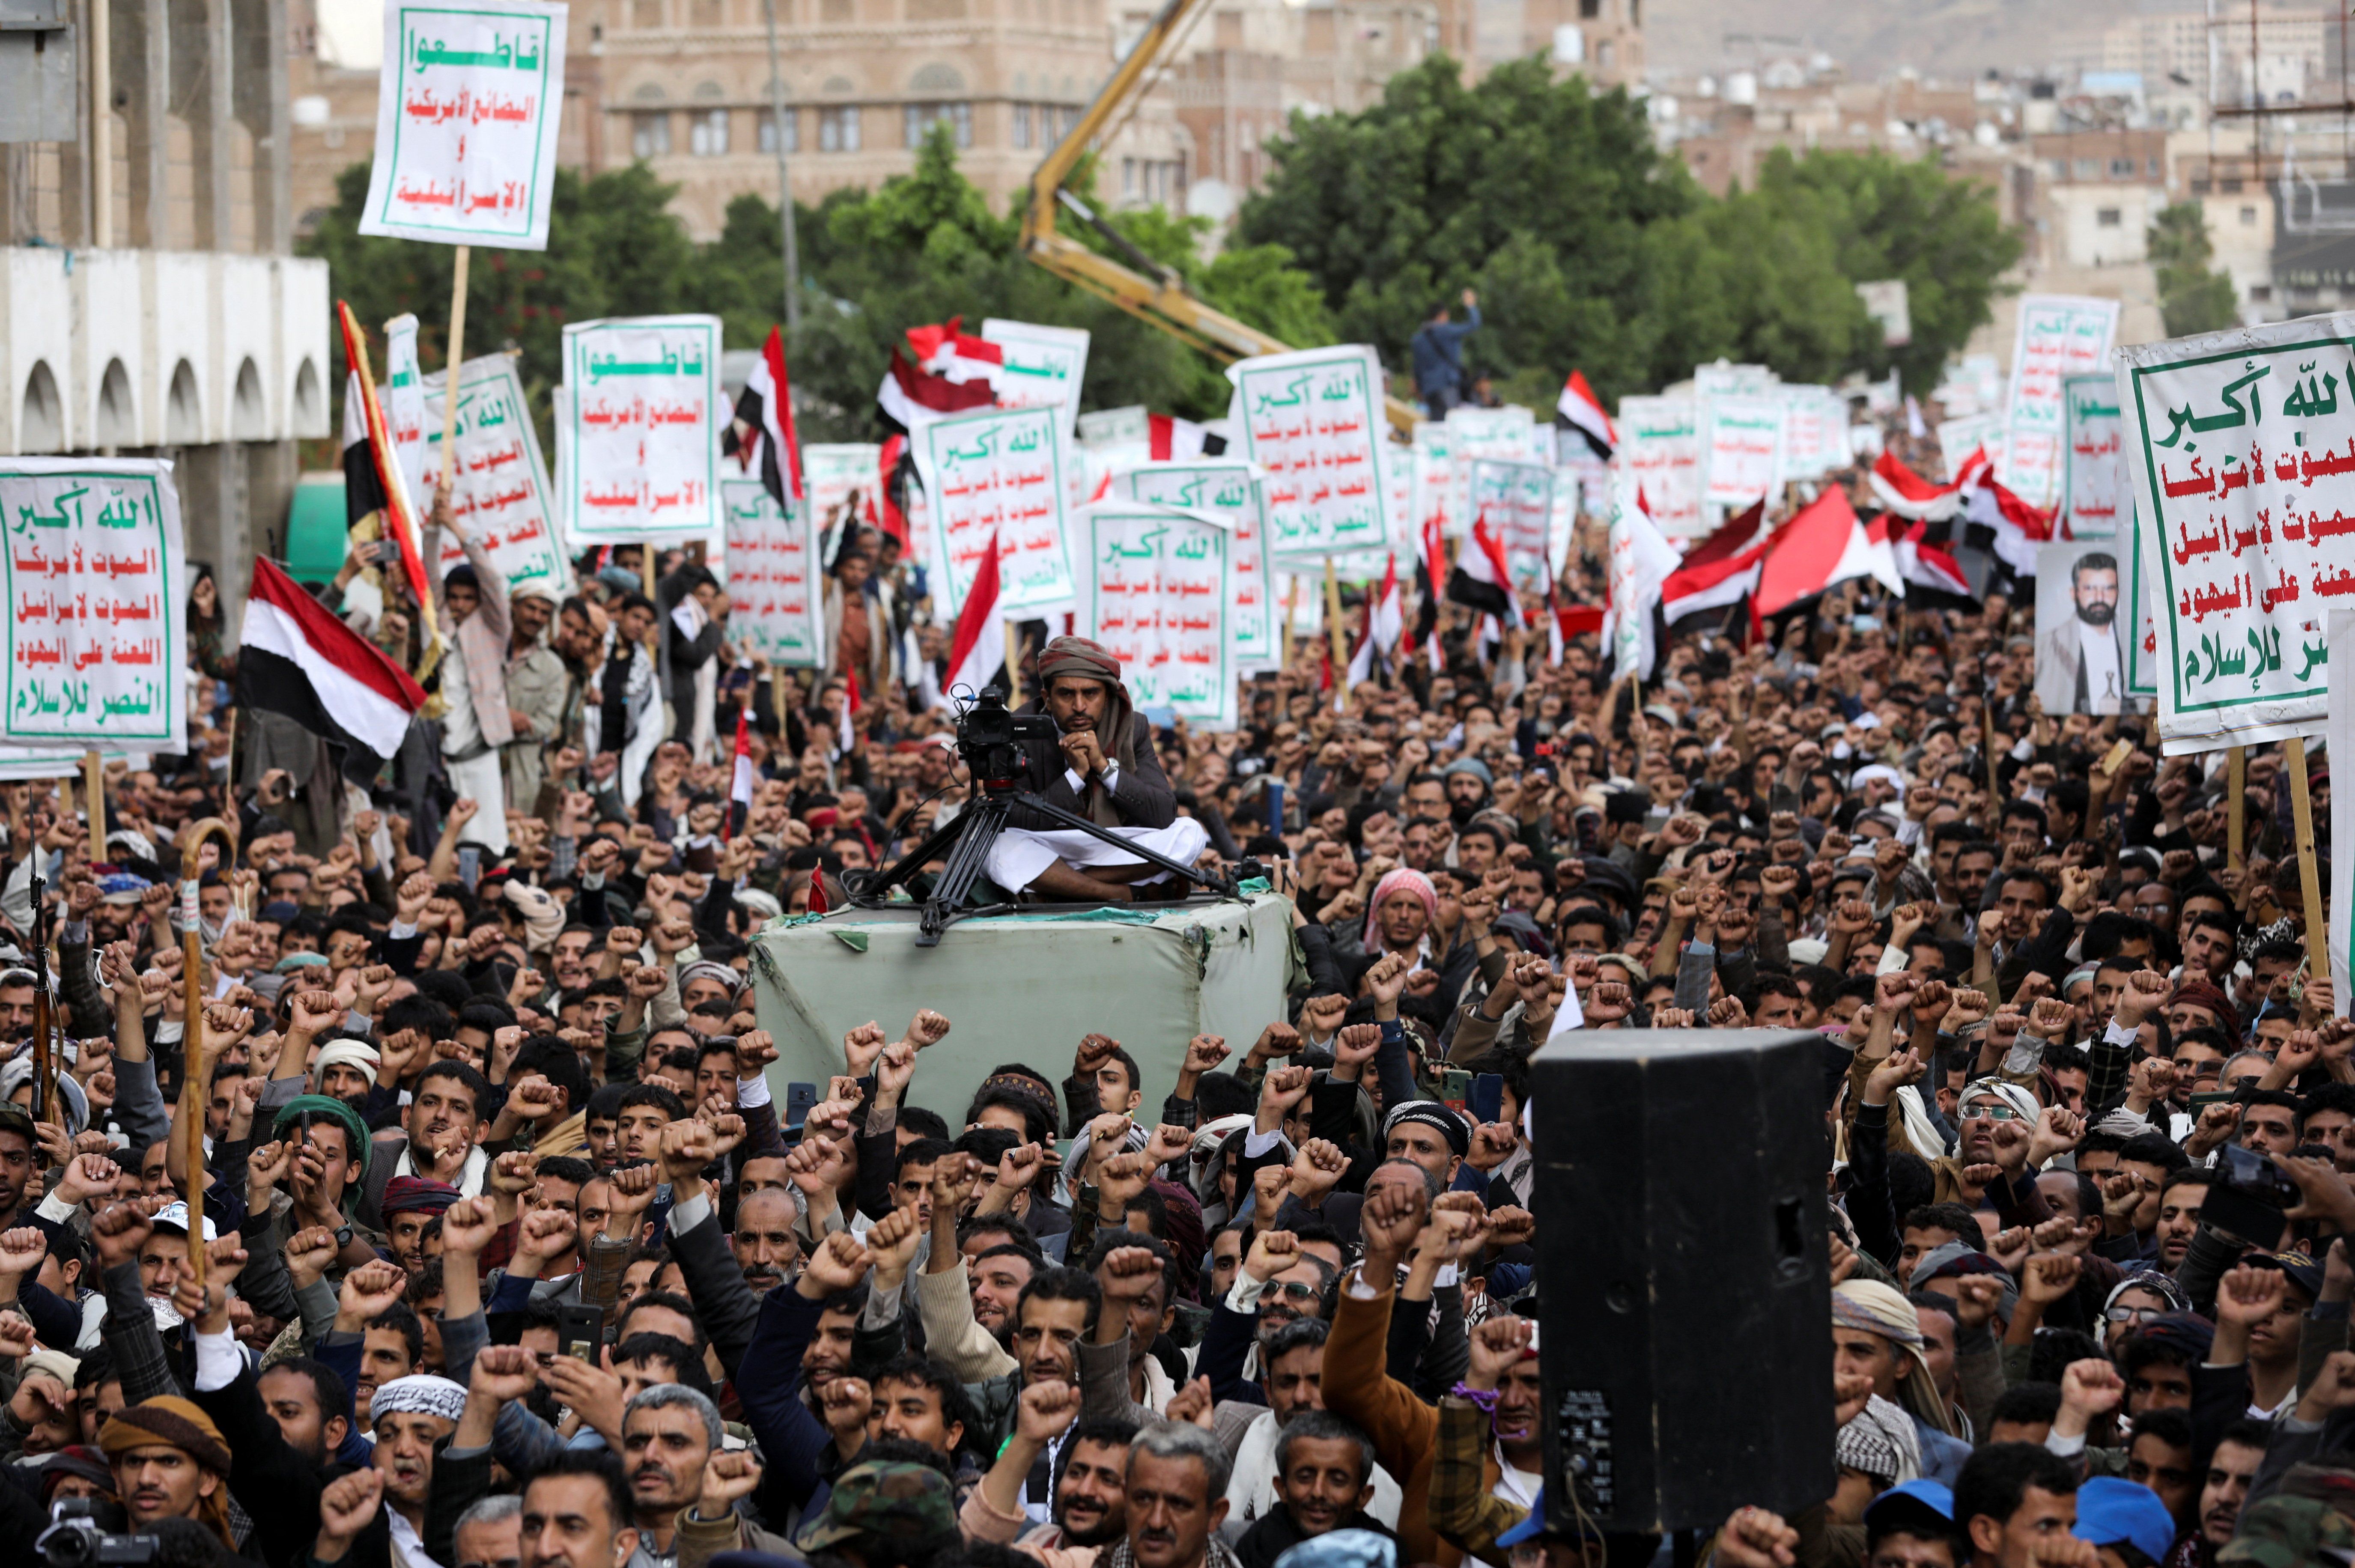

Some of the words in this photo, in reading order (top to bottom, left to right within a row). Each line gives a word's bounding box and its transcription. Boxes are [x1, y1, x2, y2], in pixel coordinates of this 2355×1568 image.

[409, 28, 538, 74] قاطعوا
[472, 90, 535, 128] البضائع
[457, 134, 465, 162] و
[396, 176, 525, 217] الإسرائيلية
[582, 343, 702, 385] قاطعوا
[1254, 370, 1314, 419] أكبر
[1321, 372, 1362, 401] الله
[477, 391, 515, 428] الله
[2153, 361, 2271, 453] أكبر
[468, 438, 526, 474] الموت
[942, 422, 1003, 472] أكبر
[1009, 421, 1050, 452] الله
[2161, 439, 2266, 503] لأمريكا
[2275, 435, 2355, 487] لموت
[11, 480, 89, 541] أكبر
[98, 487, 153, 529] الله
[480, 478, 535, 512] الموت
[1102, 522, 1170, 569] أكبر
[1175, 528, 1219, 560] الله
[1273, 510, 1321, 547] للإسلا
[2173, 507, 2273, 566] لإسرائيل
[2282, 508, 2355, 547] موت
[13, 540, 84, 579] لأمريكا
[91, 547, 156, 579] الموت
[17, 590, 87, 628] لإسرائيل
[95, 593, 159, 626] الموت
[2179, 570, 2252, 624] اليهود
[2260, 566, 2299, 615] على
[17, 637, 67, 671] اليهود
[73, 637, 103, 671] على
[111, 637, 161, 665] اللعنة
[2184, 623, 2280, 697] للإسلام
[15, 677, 89, 727] للإسلام
[95, 675, 161, 725] النصر
